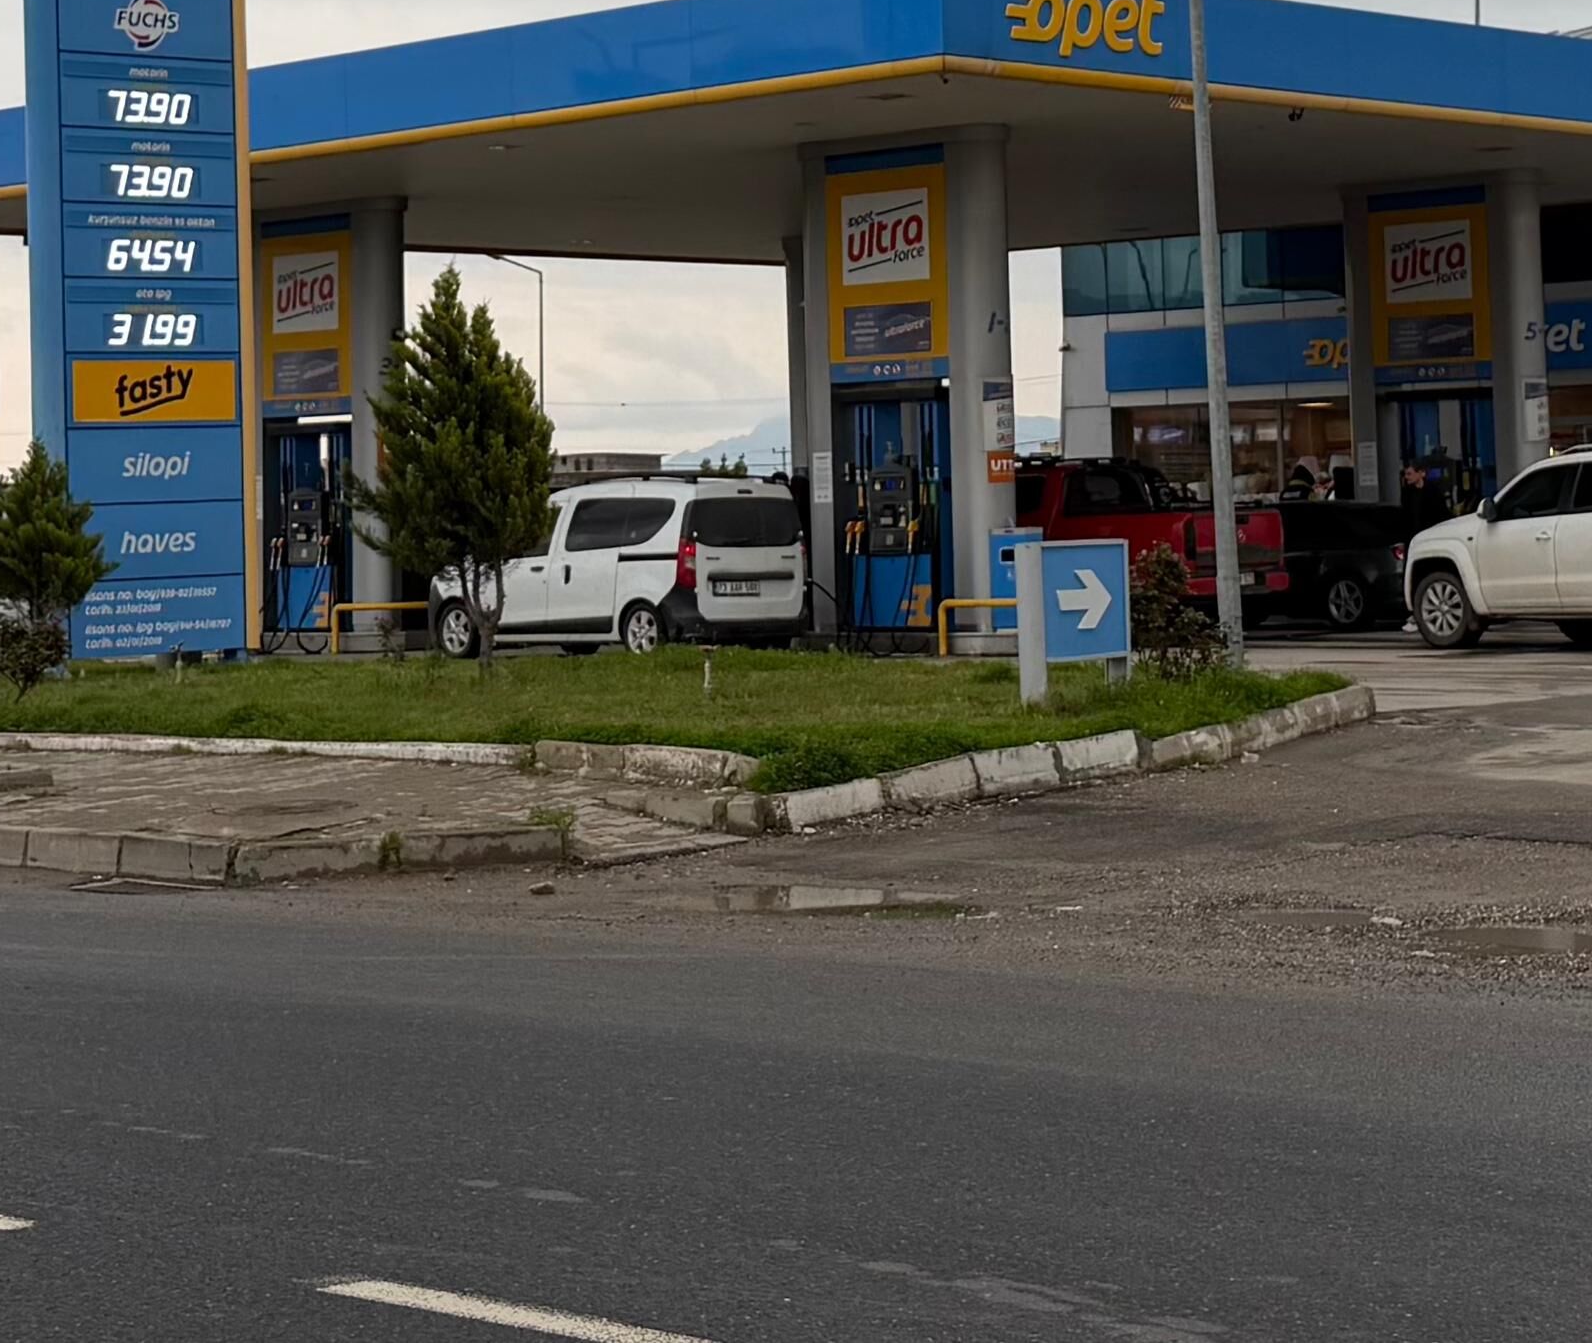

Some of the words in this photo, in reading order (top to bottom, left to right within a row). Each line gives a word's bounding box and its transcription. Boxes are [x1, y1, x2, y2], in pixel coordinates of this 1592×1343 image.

[116, 9, 177, 30] FUCHS
[129, 67, 168, 79] motorin
[131, 141, 171, 153] motorin
[848, 214, 923, 263] ultra
[893, 245, 925, 263] force
[1391, 242, 1465, 283] ultra
[277, 273, 334, 314] ultra
[115, 364, 194, 415] fasty
[122, 451, 191, 480] silopi
[120, 531, 197, 555] haves
[136, 622, 154, 635] lpg
